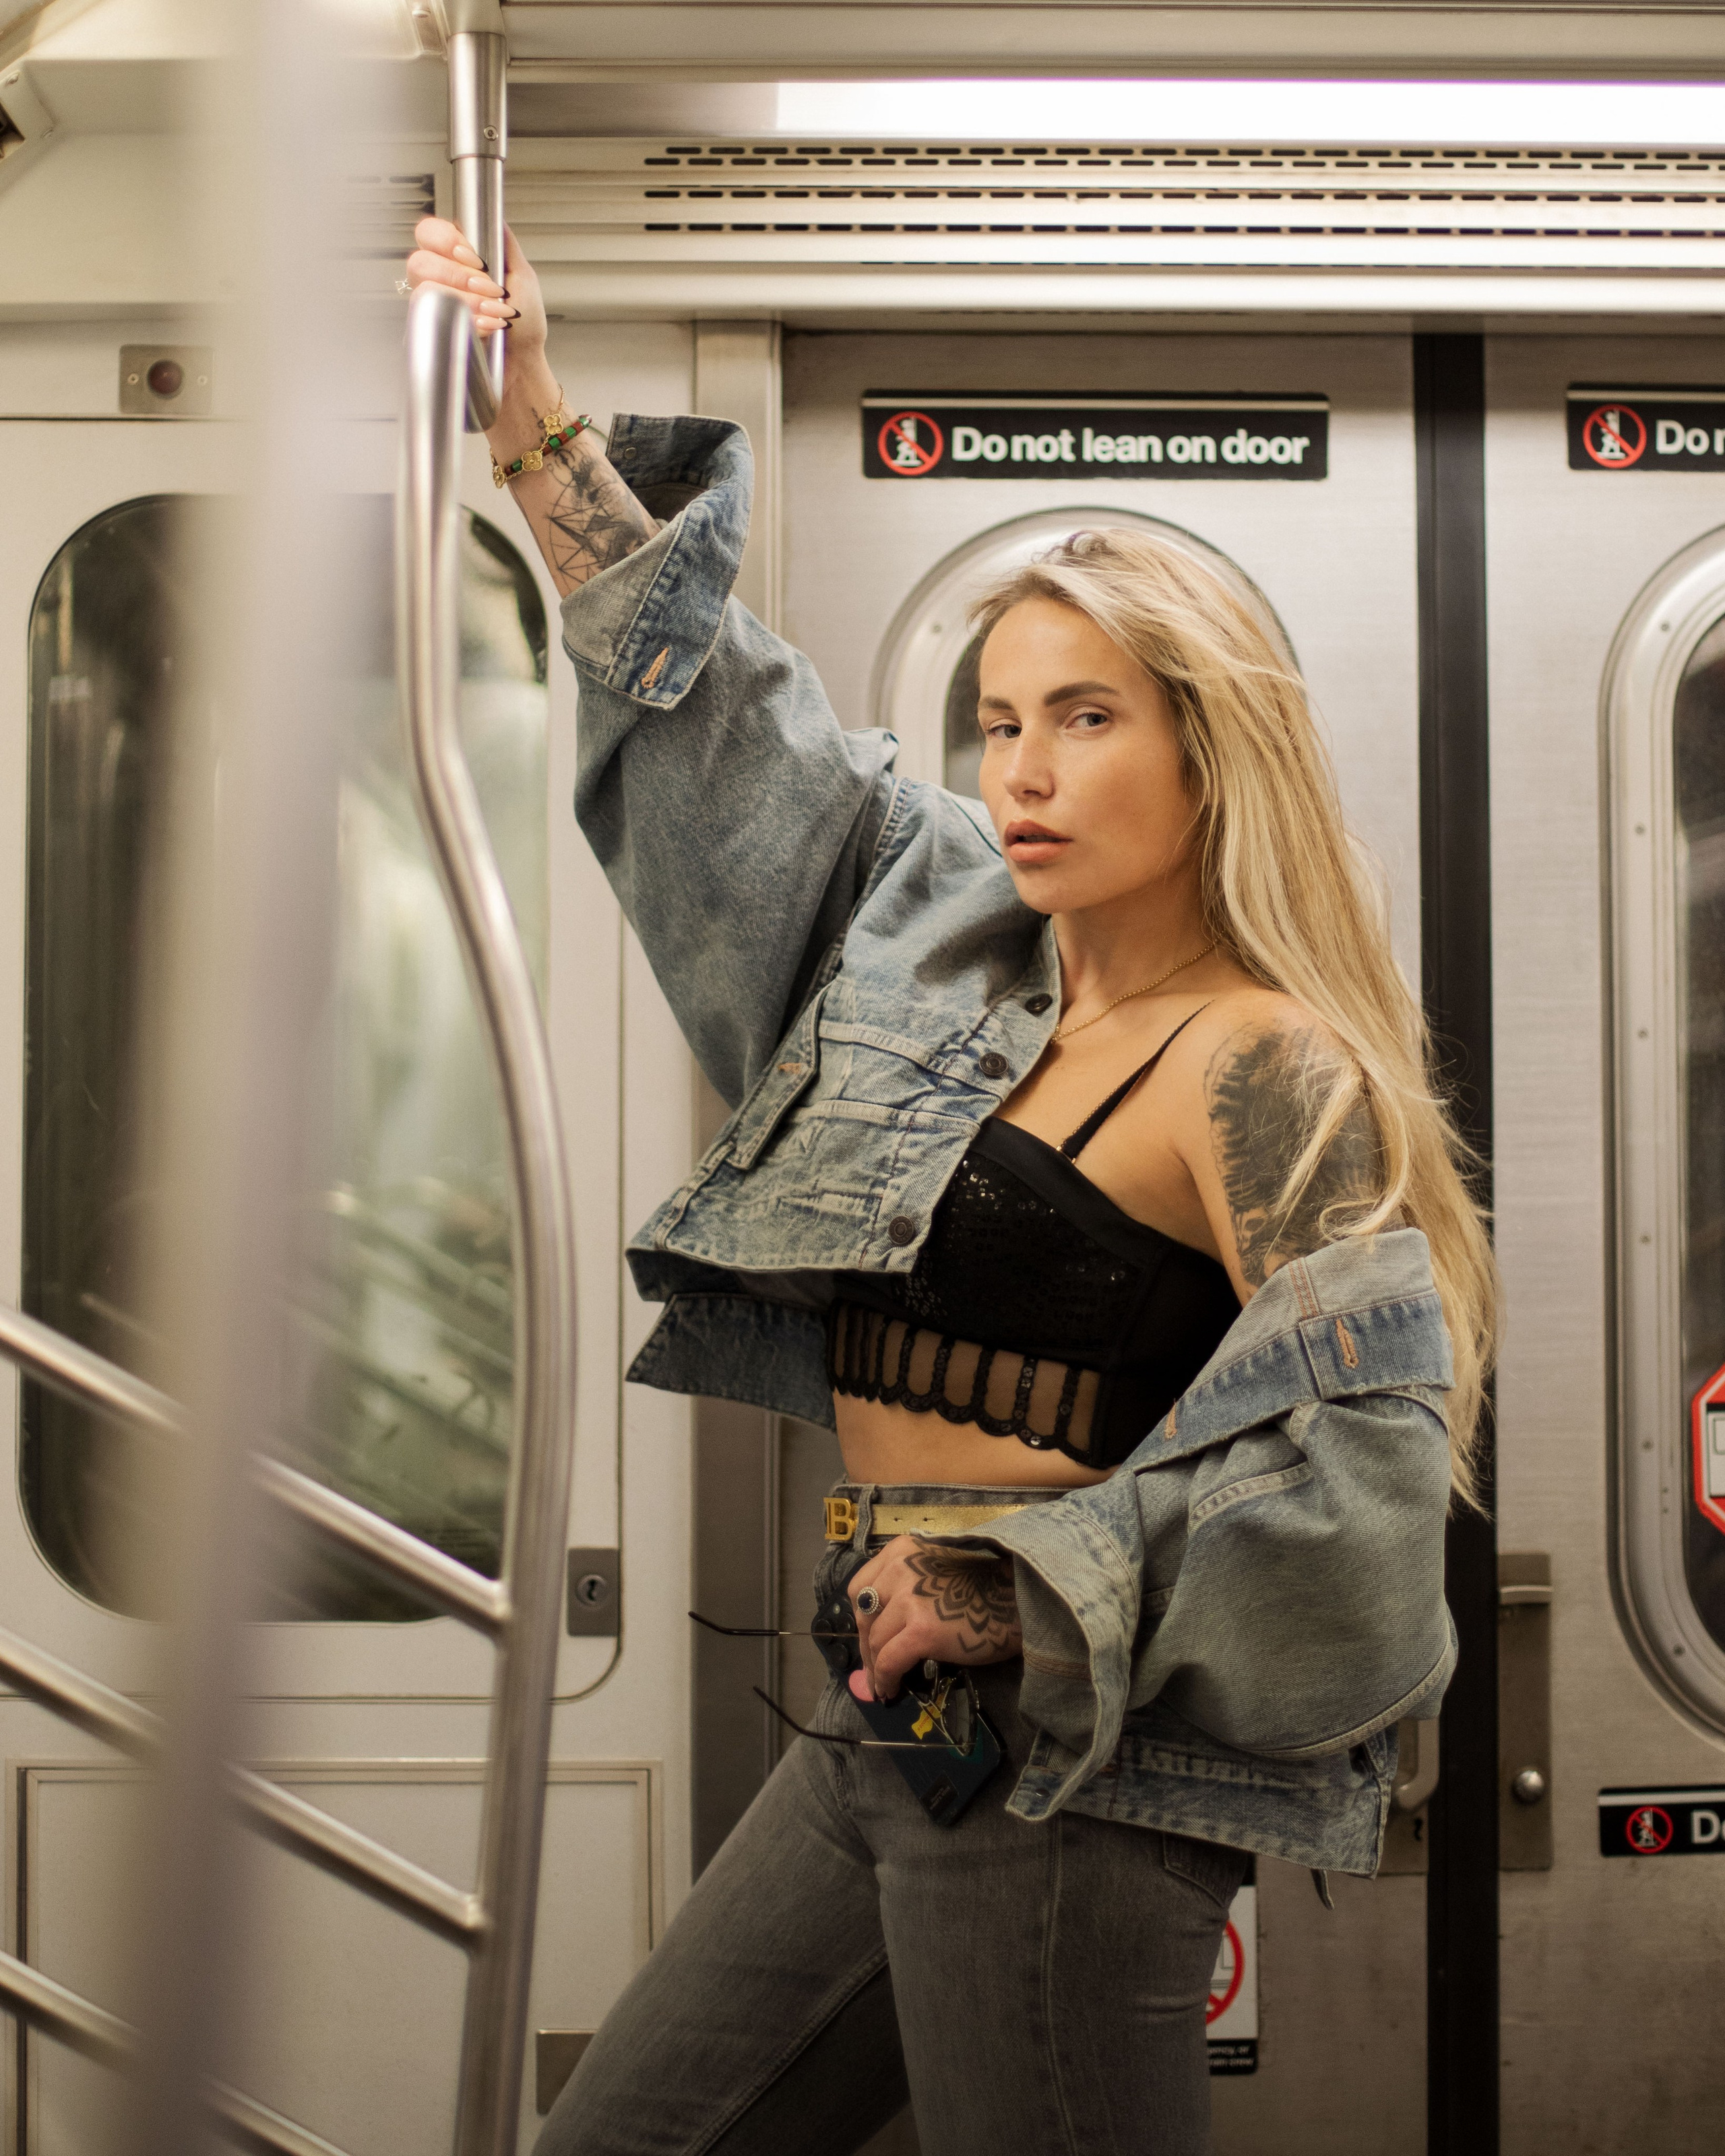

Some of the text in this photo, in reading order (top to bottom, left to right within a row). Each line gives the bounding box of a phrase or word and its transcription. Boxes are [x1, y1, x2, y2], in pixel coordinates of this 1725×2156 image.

[951, 426, 1311, 465] Do not lean on door
[1656, 420, 1710, 455] Do
[823, 1496, 853, 1541] B
[1691, 1810, 1725, 1844] D
